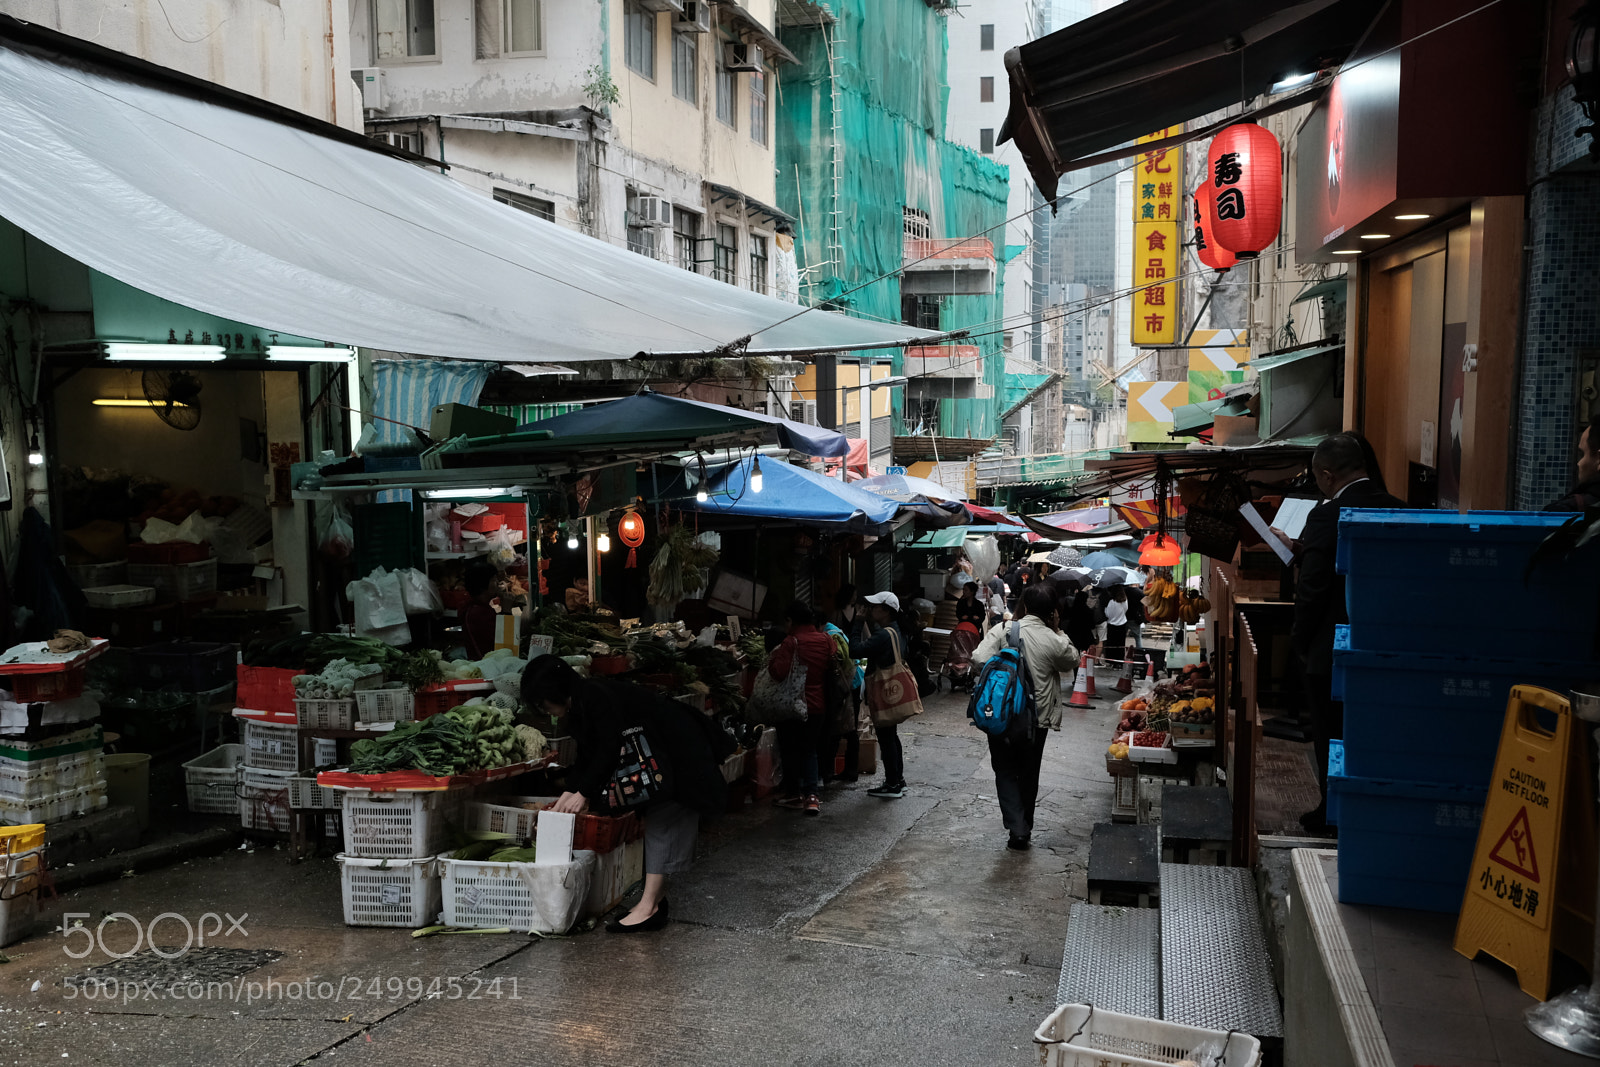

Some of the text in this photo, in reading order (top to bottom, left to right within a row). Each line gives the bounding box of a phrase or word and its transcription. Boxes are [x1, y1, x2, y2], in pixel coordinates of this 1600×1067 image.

[1141, 182, 1156, 220] 家禽
[1158, 182, 1173, 219] 鮮肉
[1214, 152, 1245, 220] 寿司
[1144, 230, 1167, 333] 食品超市
[1502, 780, 1549, 809] WET FLOOR
[1509, 767, 1546, 793] CAUTION
[1480, 867, 1539, 916] 小心地滑
